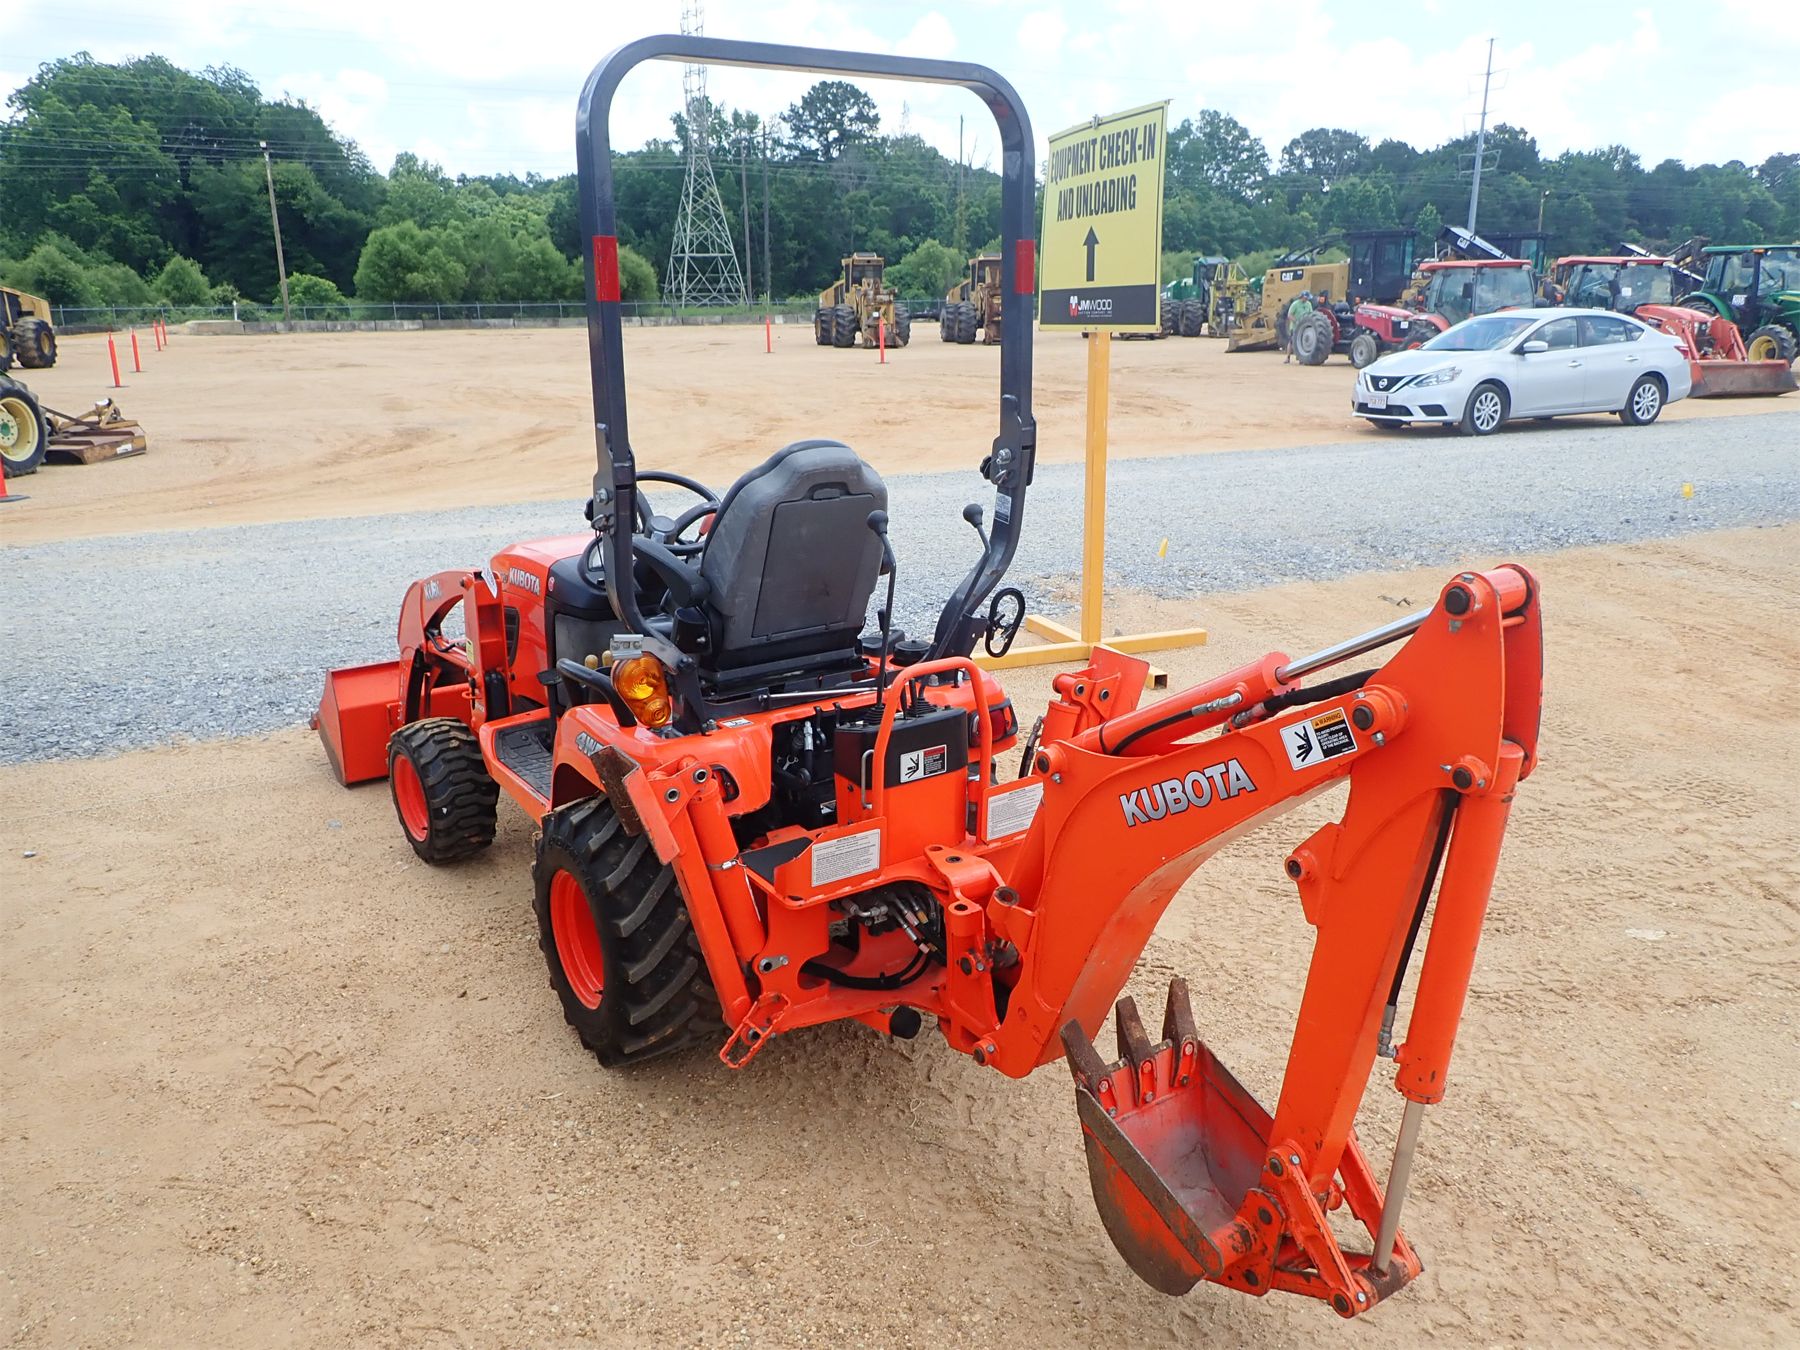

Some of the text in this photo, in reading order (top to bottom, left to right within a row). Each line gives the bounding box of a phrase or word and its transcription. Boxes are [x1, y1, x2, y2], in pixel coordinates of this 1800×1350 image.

[1050, 122, 1157, 186] EQUIPMENT CHECK-IN
[1057, 174, 1137, 222] AND UNLOADING
[1457, 237, 1470, 249] CAT
[1281, 272, 1294, 281] CAT
[509, 567, 540, 596] KUBOTA
[1320, 713, 1341, 723] WARNING
[1119, 758, 1258, 827] KUBOTA
